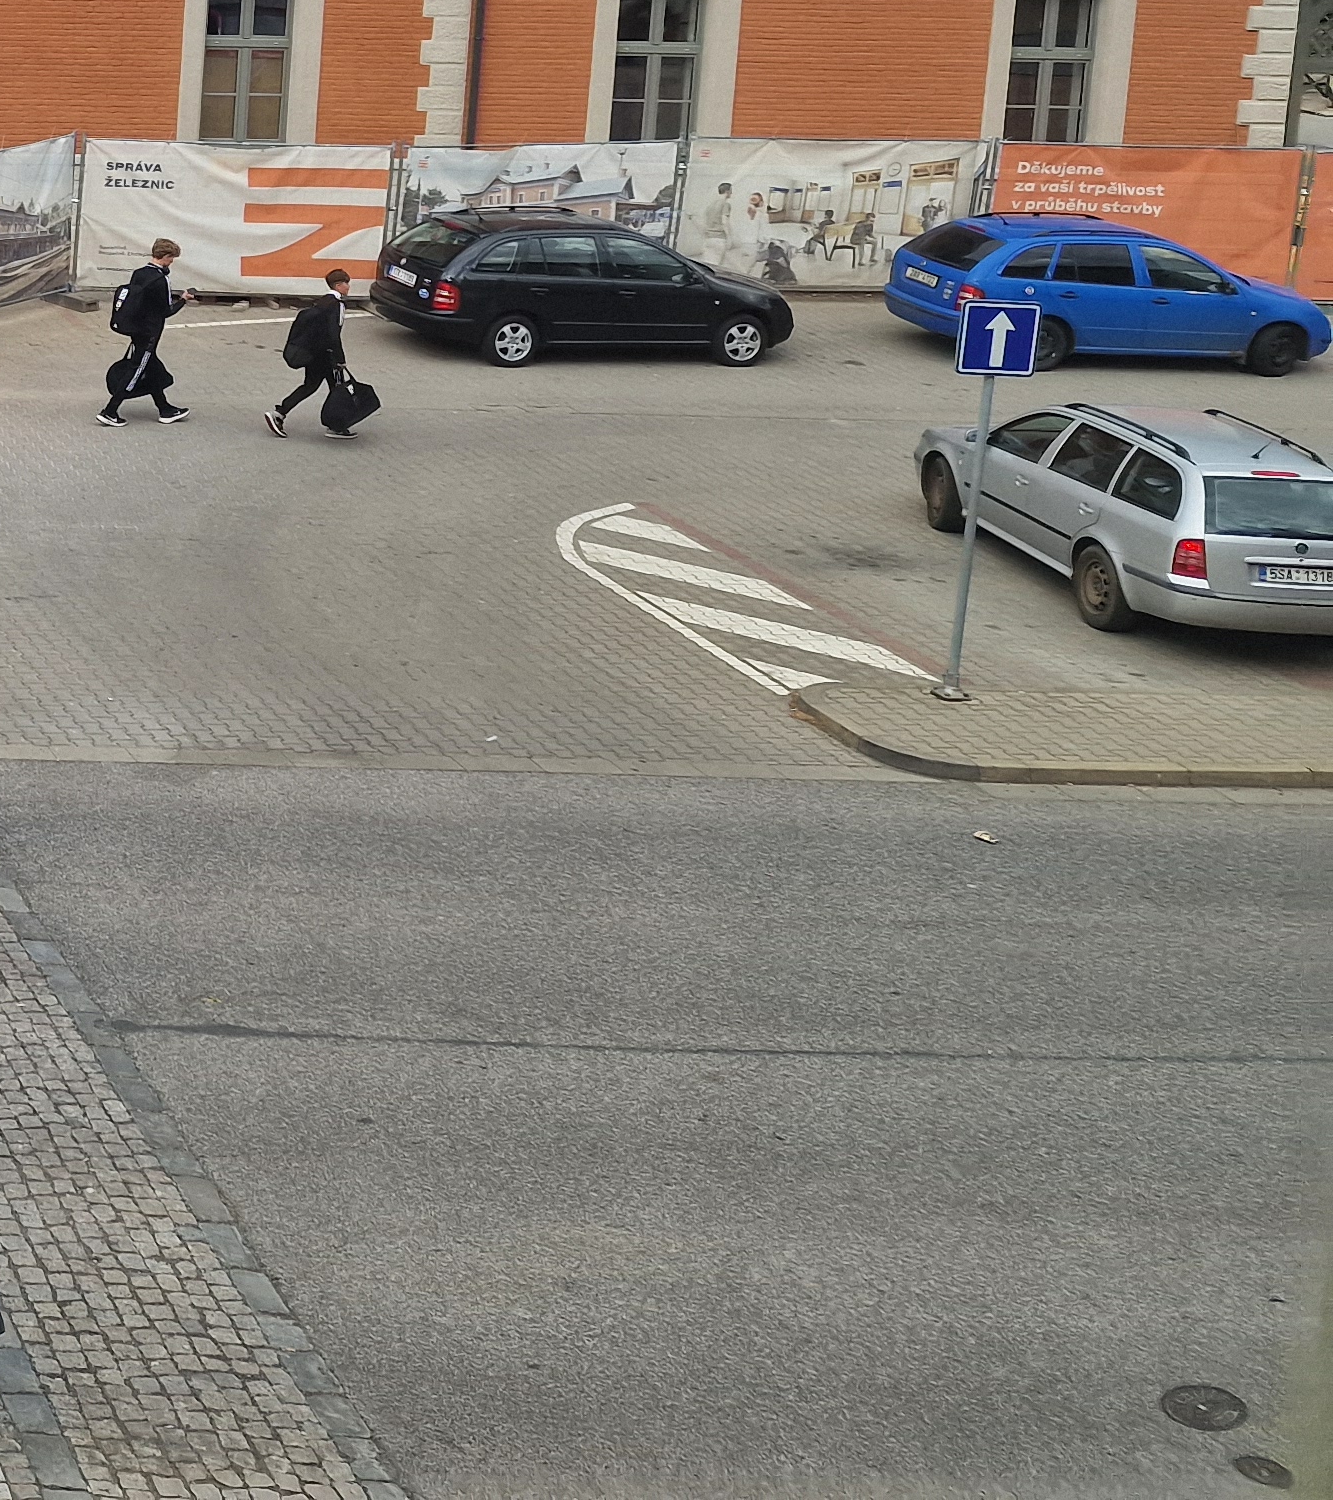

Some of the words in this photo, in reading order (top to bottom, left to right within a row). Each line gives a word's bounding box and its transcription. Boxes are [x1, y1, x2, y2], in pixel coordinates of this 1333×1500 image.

[106, 161, 162, 173] SPRÁVA
[1017, 161, 1104, 177] Děkujeme
[104, 176, 175, 189] ŽELEZNIC
[1013, 182, 1035, 192] za
[1040, 180, 1075, 193] vaší
[1078, 182, 1165, 196] trpělivost
[1011, 200, 1020, 210] v
[1024, 197, 1098, 212] průběhu
[1101, 202, 1163, 217] stavby
[1269, 568, 1293, 580] 5SA
